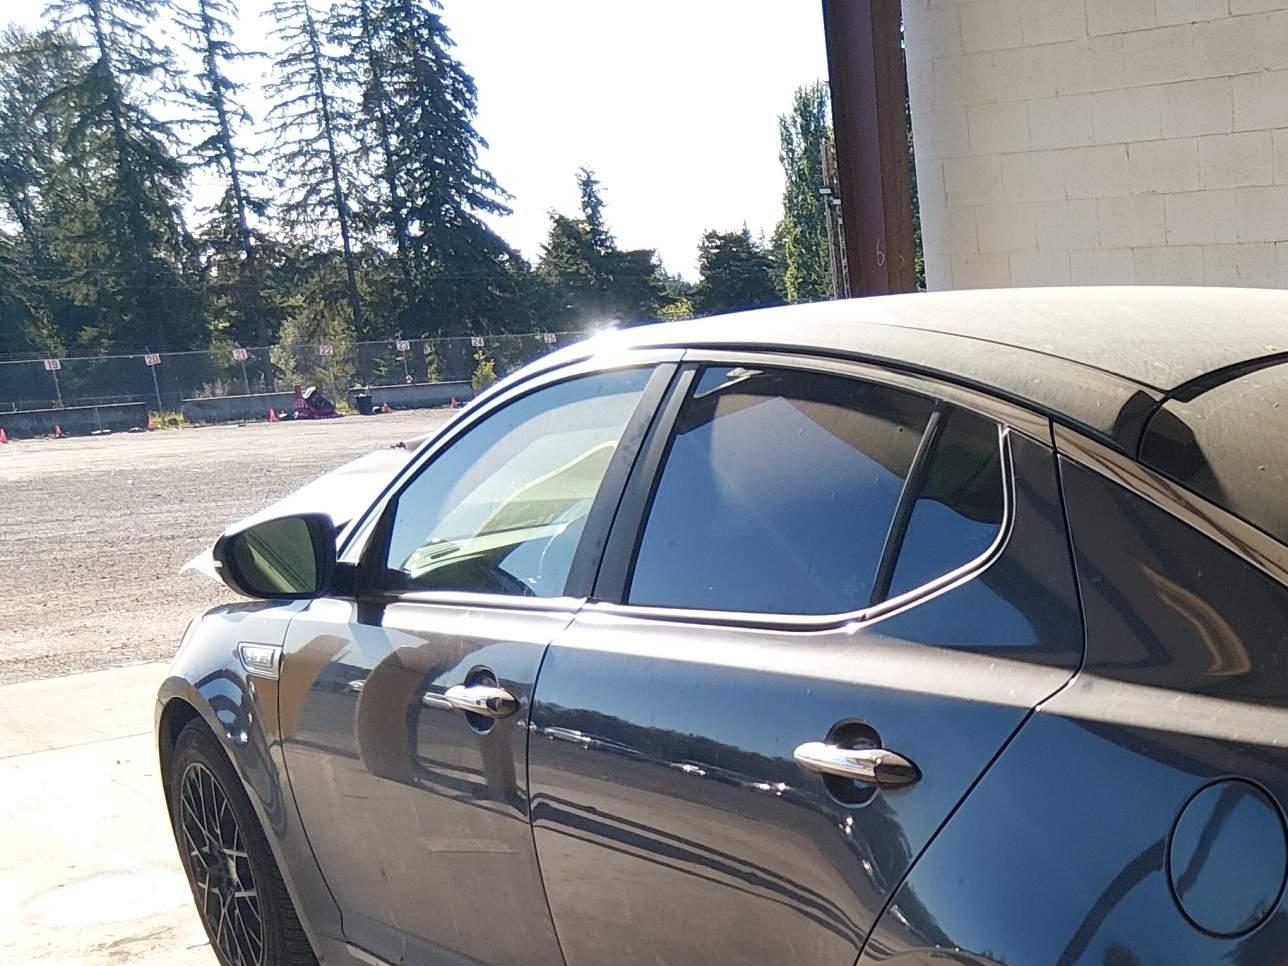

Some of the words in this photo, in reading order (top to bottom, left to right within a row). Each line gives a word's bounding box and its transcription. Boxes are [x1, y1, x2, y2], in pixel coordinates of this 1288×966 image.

[473, 337, 482, 346] 24
[146, 354, 160, 364] 20
[47, 360, 58, 369] 19
